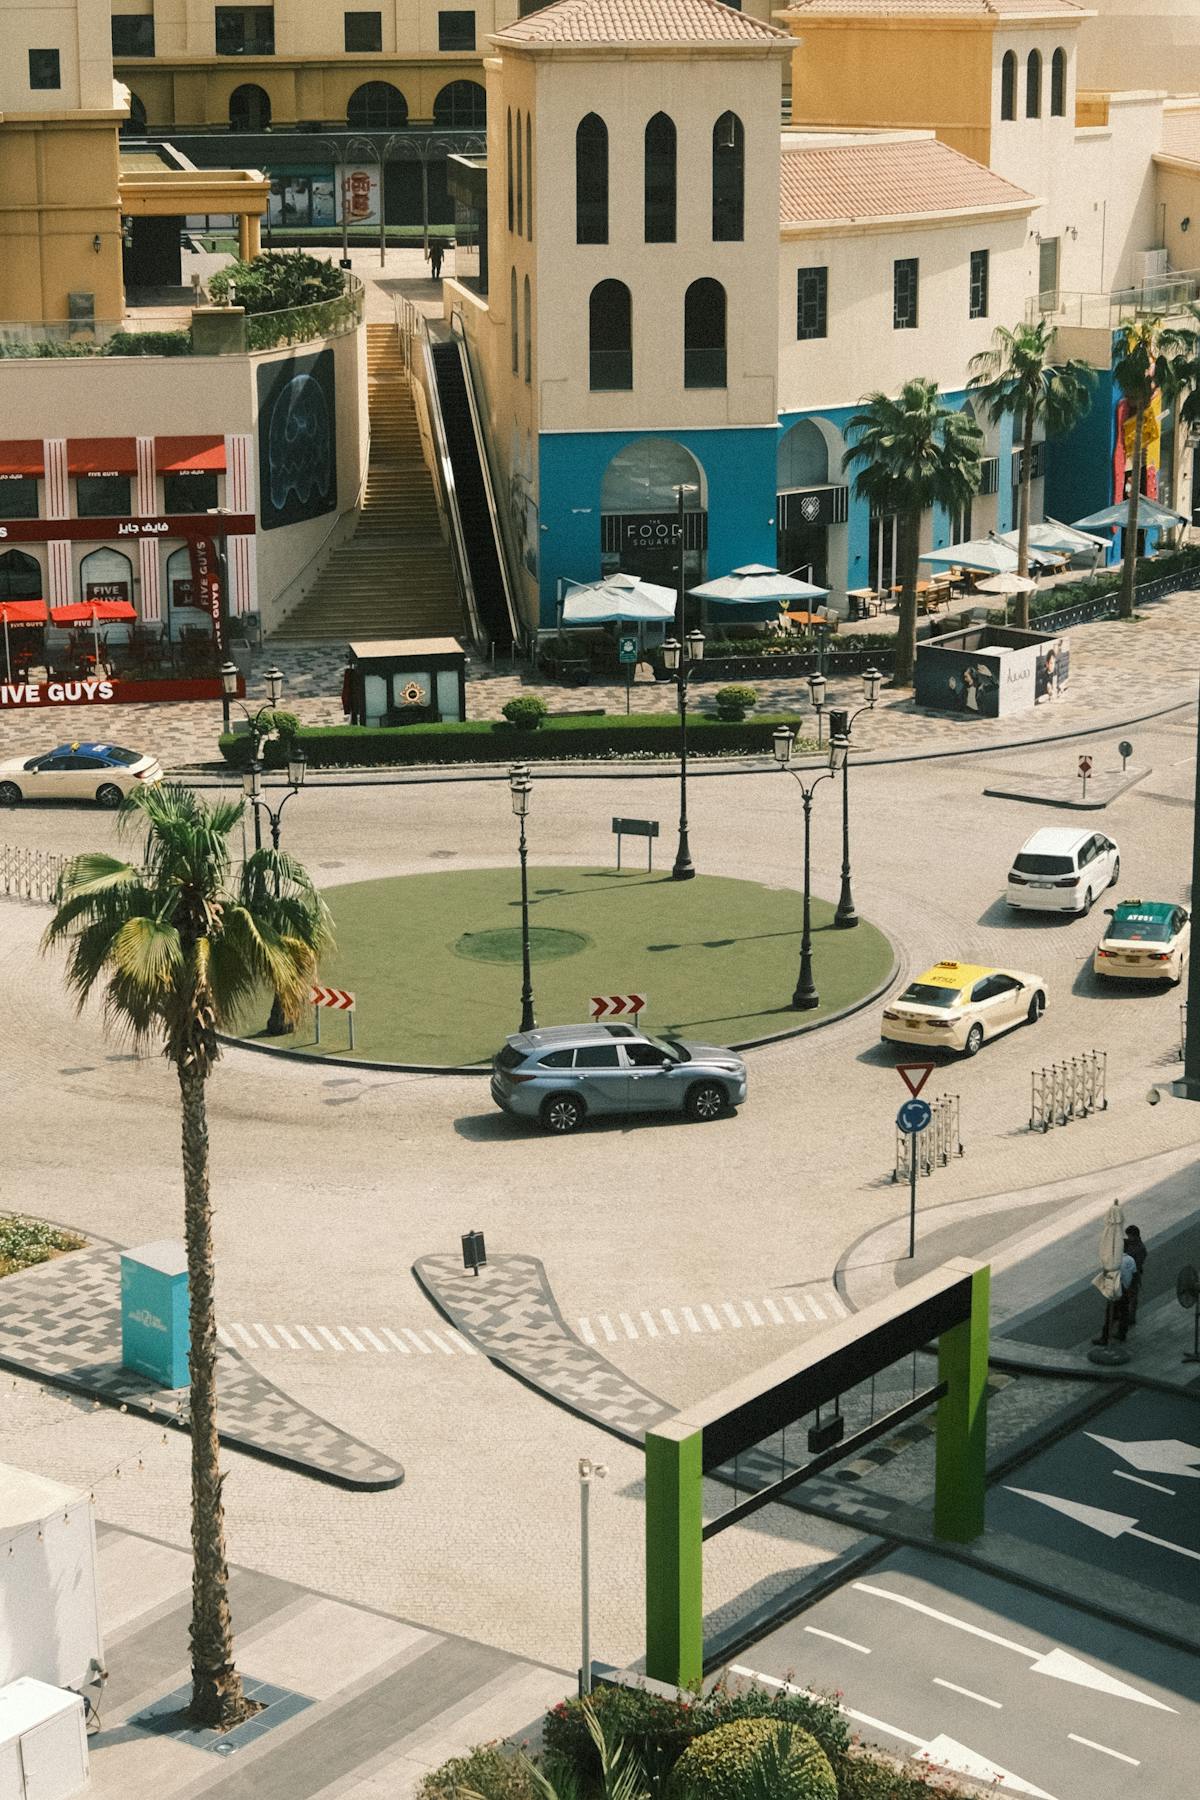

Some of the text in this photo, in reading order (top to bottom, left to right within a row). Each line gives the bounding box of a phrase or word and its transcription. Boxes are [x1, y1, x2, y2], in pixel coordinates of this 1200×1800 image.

[118, 522, 169, 535] فايف جايز
[627, 524, 680, 538] FOOD
[633, 538, 677, 546] SQUARE
[196, 541, 209, 606] FIVE GUYS
[93, 585, 120, 595] FIVE
[211, 582, 220, 619] GUYS
[0, 681, 114, 704] IVE GUYS
